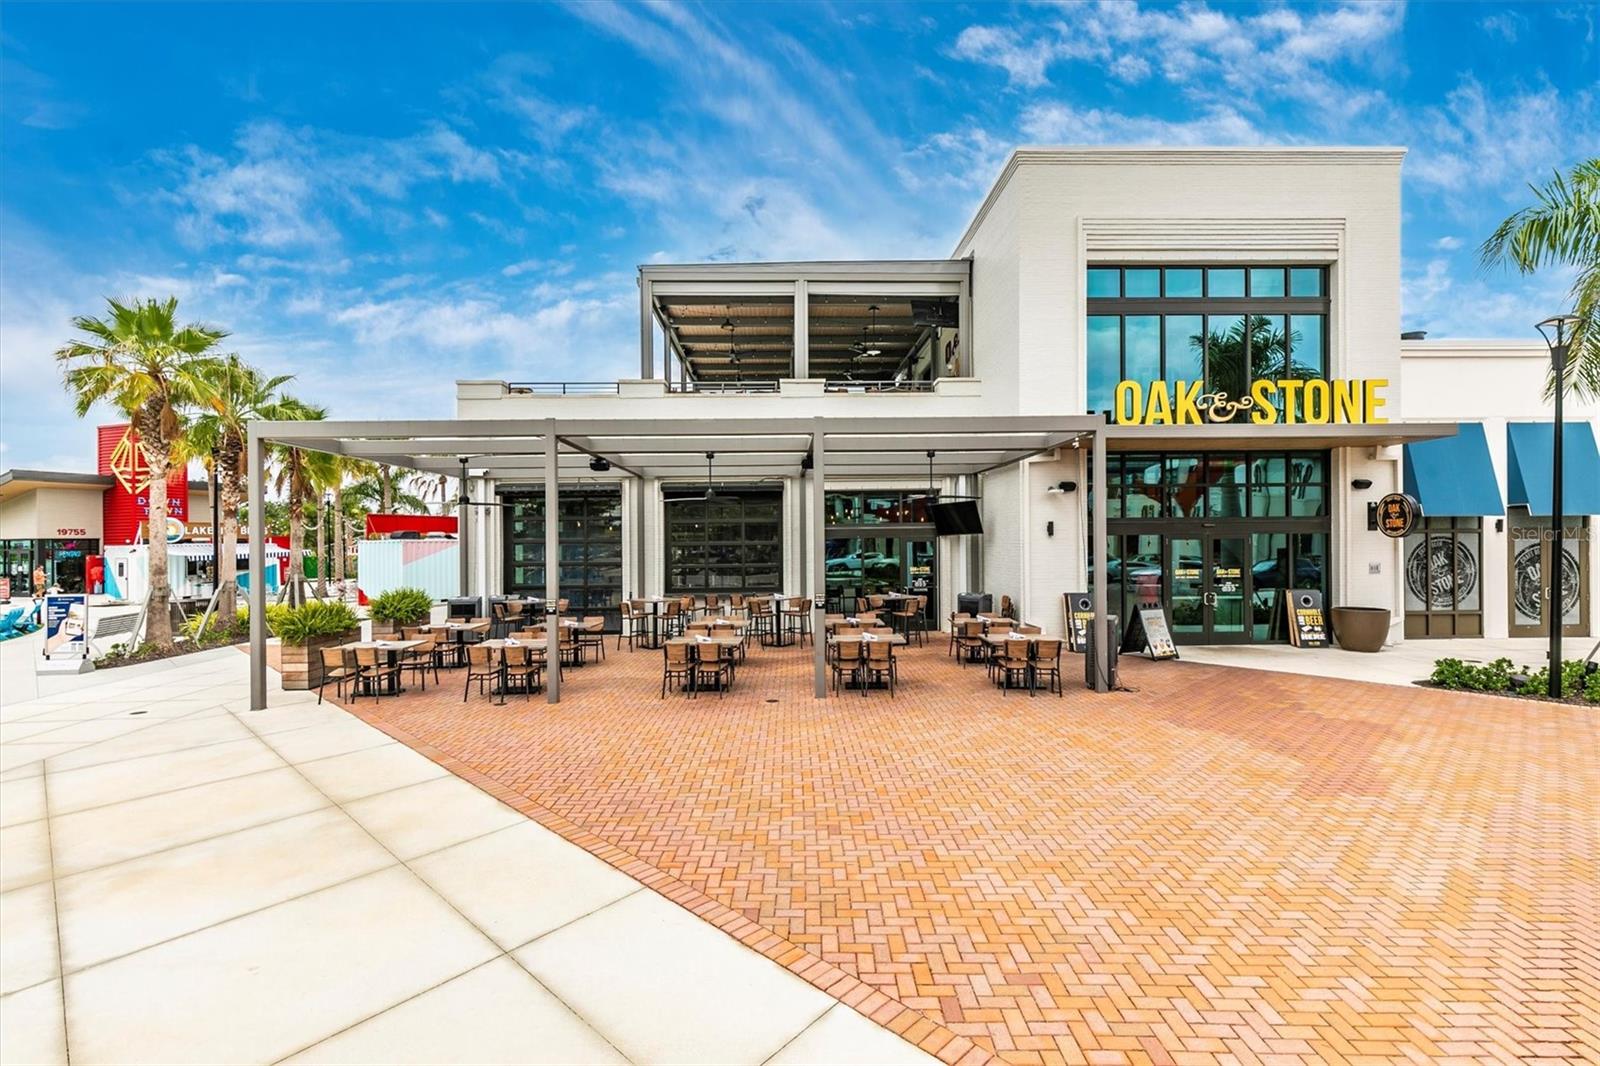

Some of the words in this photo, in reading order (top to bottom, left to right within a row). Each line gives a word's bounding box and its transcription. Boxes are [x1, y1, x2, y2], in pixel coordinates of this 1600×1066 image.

[1114, 380, 1204, 425] OAK
[1196, 391, 1254, 422] &
[1251, 379, 1388, 425] STONE
